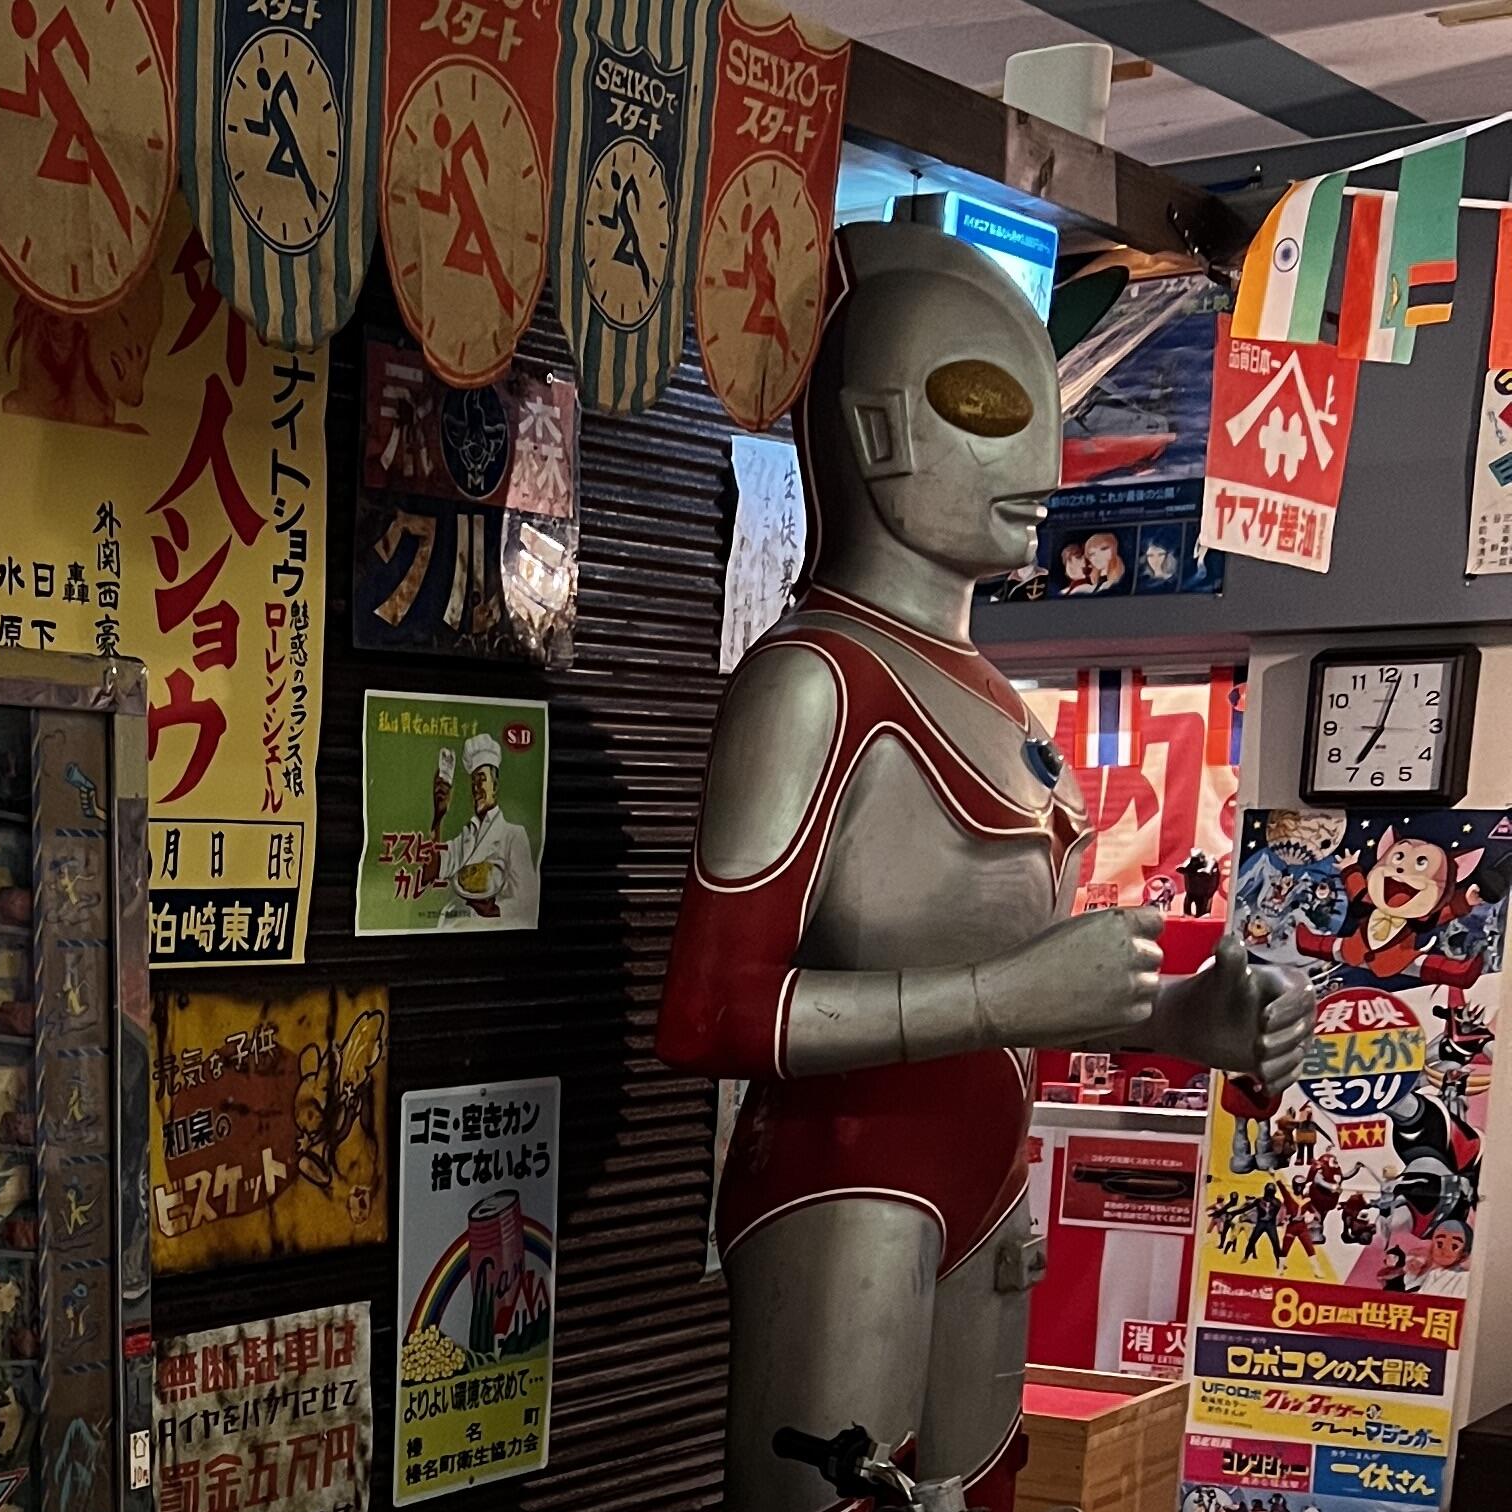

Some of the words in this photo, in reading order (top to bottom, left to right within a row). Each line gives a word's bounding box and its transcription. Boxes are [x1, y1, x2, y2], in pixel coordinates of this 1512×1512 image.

[605, 97, 663, 140] スタート
[736, 98, 818, 153] スタート
[1228, 340, 1282, 375] 品質日本一
[1215, 487, 1317, 557] ヤマサ醤油
[1351, 674, 1367, 690] 11
[1379, 667, 1397, 684] 12
[1412, 673, 1420, 689] 1
[1329, 694, 1348, 709] 10
[1425, 690, 1440, 706] 2
[1323, 721, 1338, 736] 9
[1429, 719, 1443, 734] 3
[1328, 748, 1341, 763] 8
[1418, 747, 1432, 761] 4
[1345, 767, 1359, 782] 7
[1370, 771, 1384, 787] 6
[1398, 766, 1412, 782] 5
[1314, 996, 1410, 1034] 東映
[153, 1022, 278, 1100] 元気な子供
[1303, 1028, 1424, 1076] まんが
[1311, 1074, 1402, 1110] まつり
[432, 1142, 552, 1192] 捨てないよう
[154, 1147, 288, 1238] ビスケット
[1272, 1287, 1459, 1349] 80日間世界一周
[156, 1318, 357, 1405] 無断駐車は
[1227, 1344, 1433, 1389] ロボコンの大冒険
[1330, 1461, 1437, 1497] 一休さん
